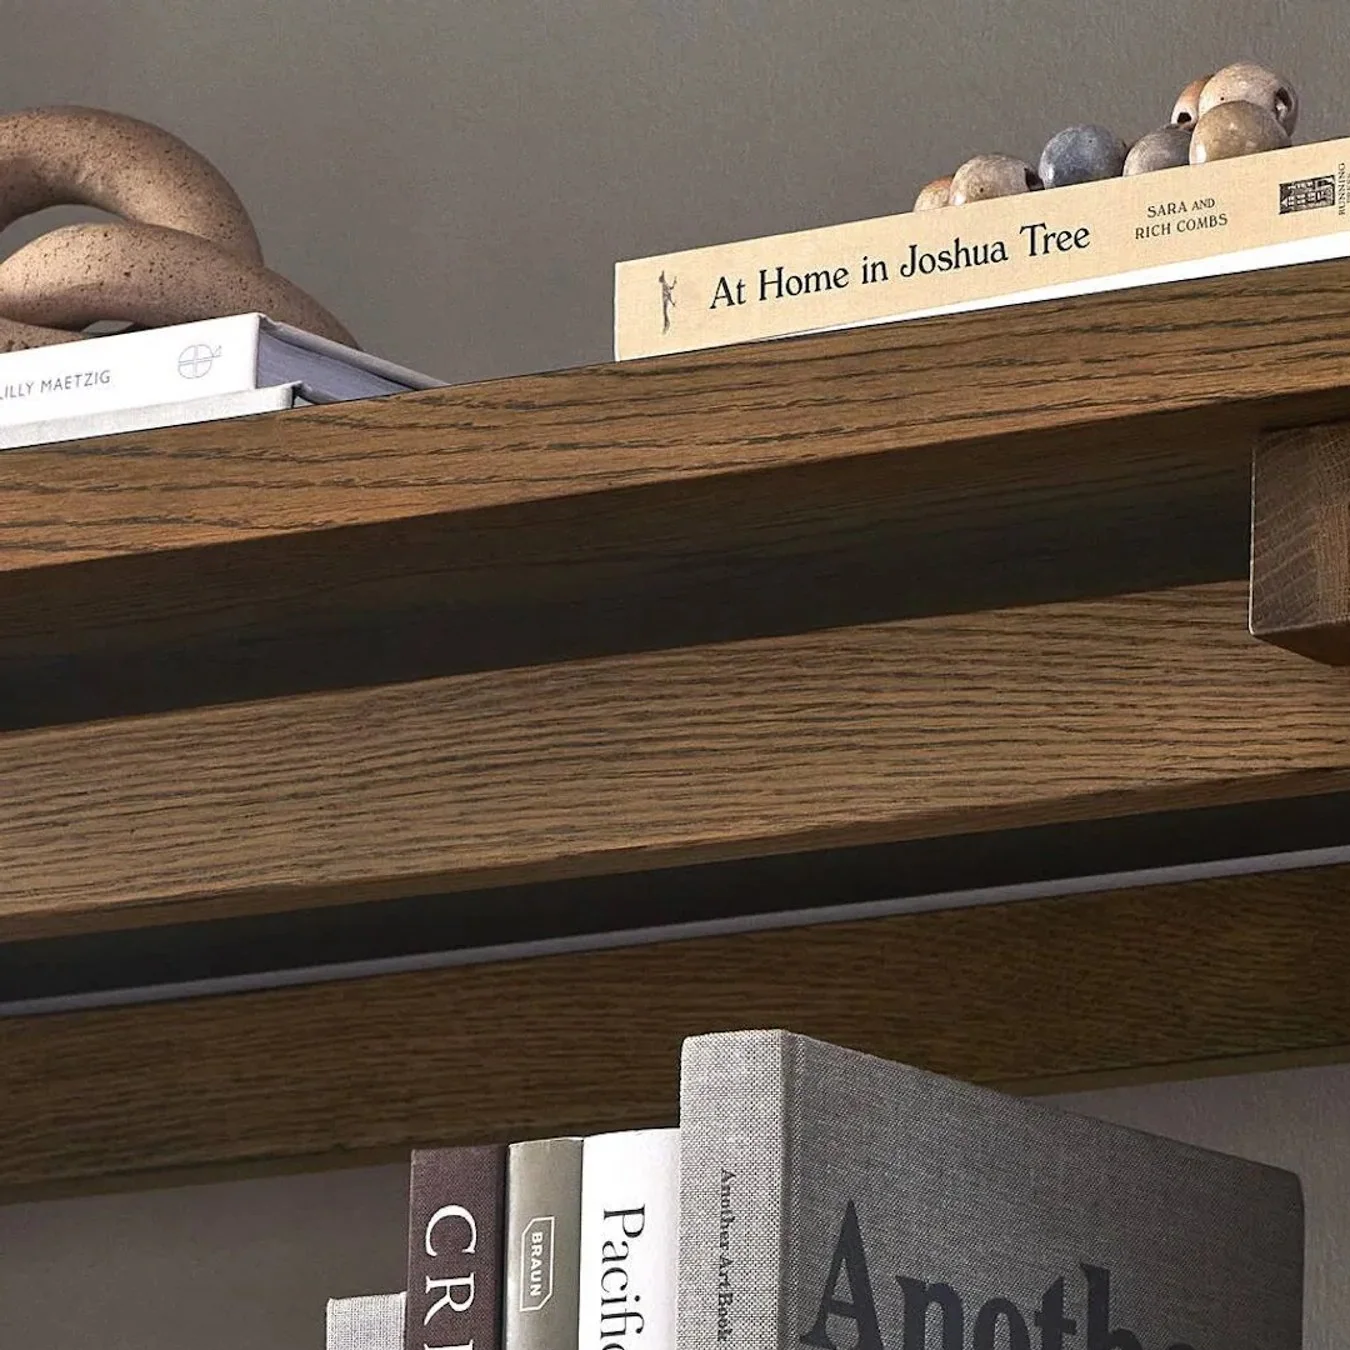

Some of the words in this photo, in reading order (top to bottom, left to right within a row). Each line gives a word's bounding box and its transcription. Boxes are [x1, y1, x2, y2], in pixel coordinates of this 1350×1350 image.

[1135, 223, 1171, 239] RICH
[1176, 213, 1228, 233] COMBS
[1147, 203, 1188, 218] SARA
[1191, 197, 1216, 210] AND
[710, 276, 746, 309] At
[759, 266, 849, 301] Home
[861, 255, 888, 284] in
[900, 238, 1008, 278] Joshua
[1019, 222, 1091, 257] Tree
[0, 381, 34, 400] ILLY
[40, 369, 111, 393] MAETZIG
[719, 1167, 737, 1251] Another
[529, 1230, 544, 1298] BRAUN
[718, 1253, 735, 1289] Art
[717, 1292, 734, 1342] Book
